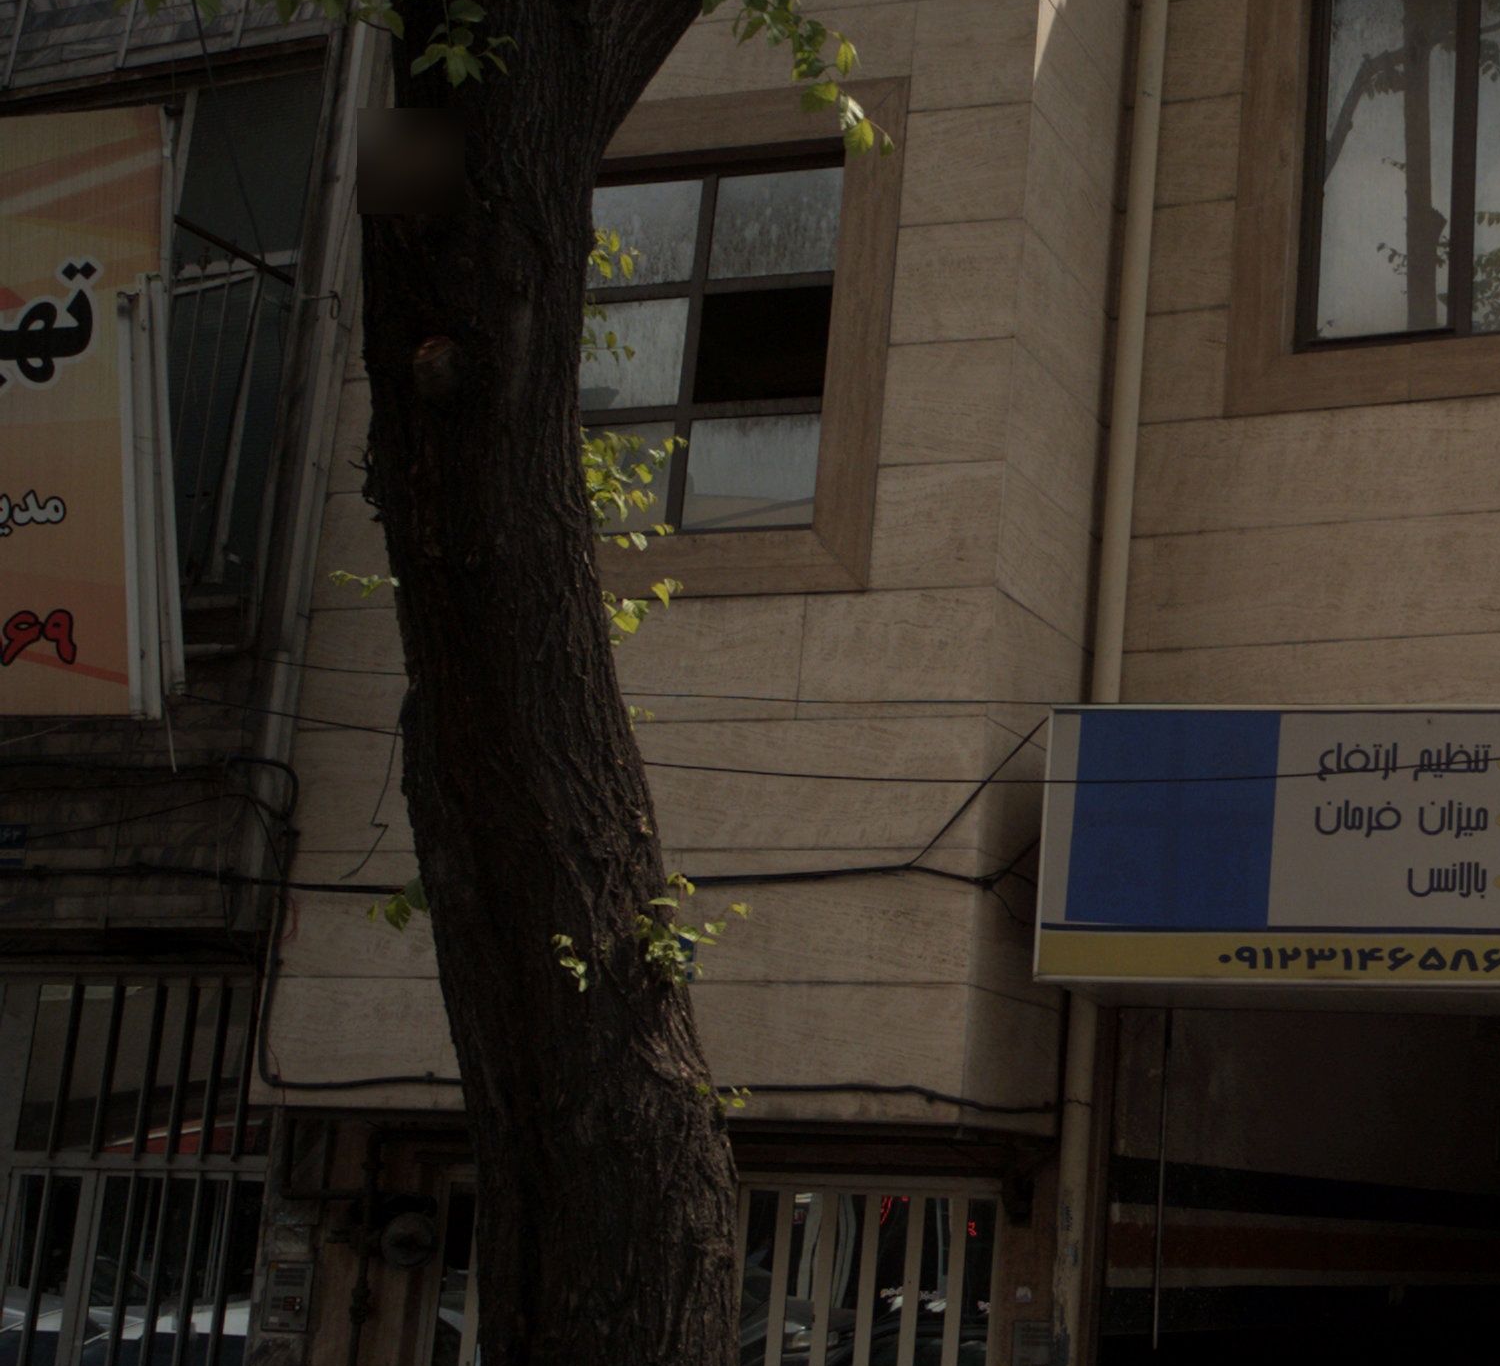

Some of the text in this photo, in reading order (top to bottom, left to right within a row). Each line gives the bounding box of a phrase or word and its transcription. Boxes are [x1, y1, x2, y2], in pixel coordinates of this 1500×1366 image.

[1317, 741, 1490, 782] تنظیم ارتفاع
[1313, 799, 1490, 839] میزان فرمان
[1406, 861, 1489, 900] بالانس
